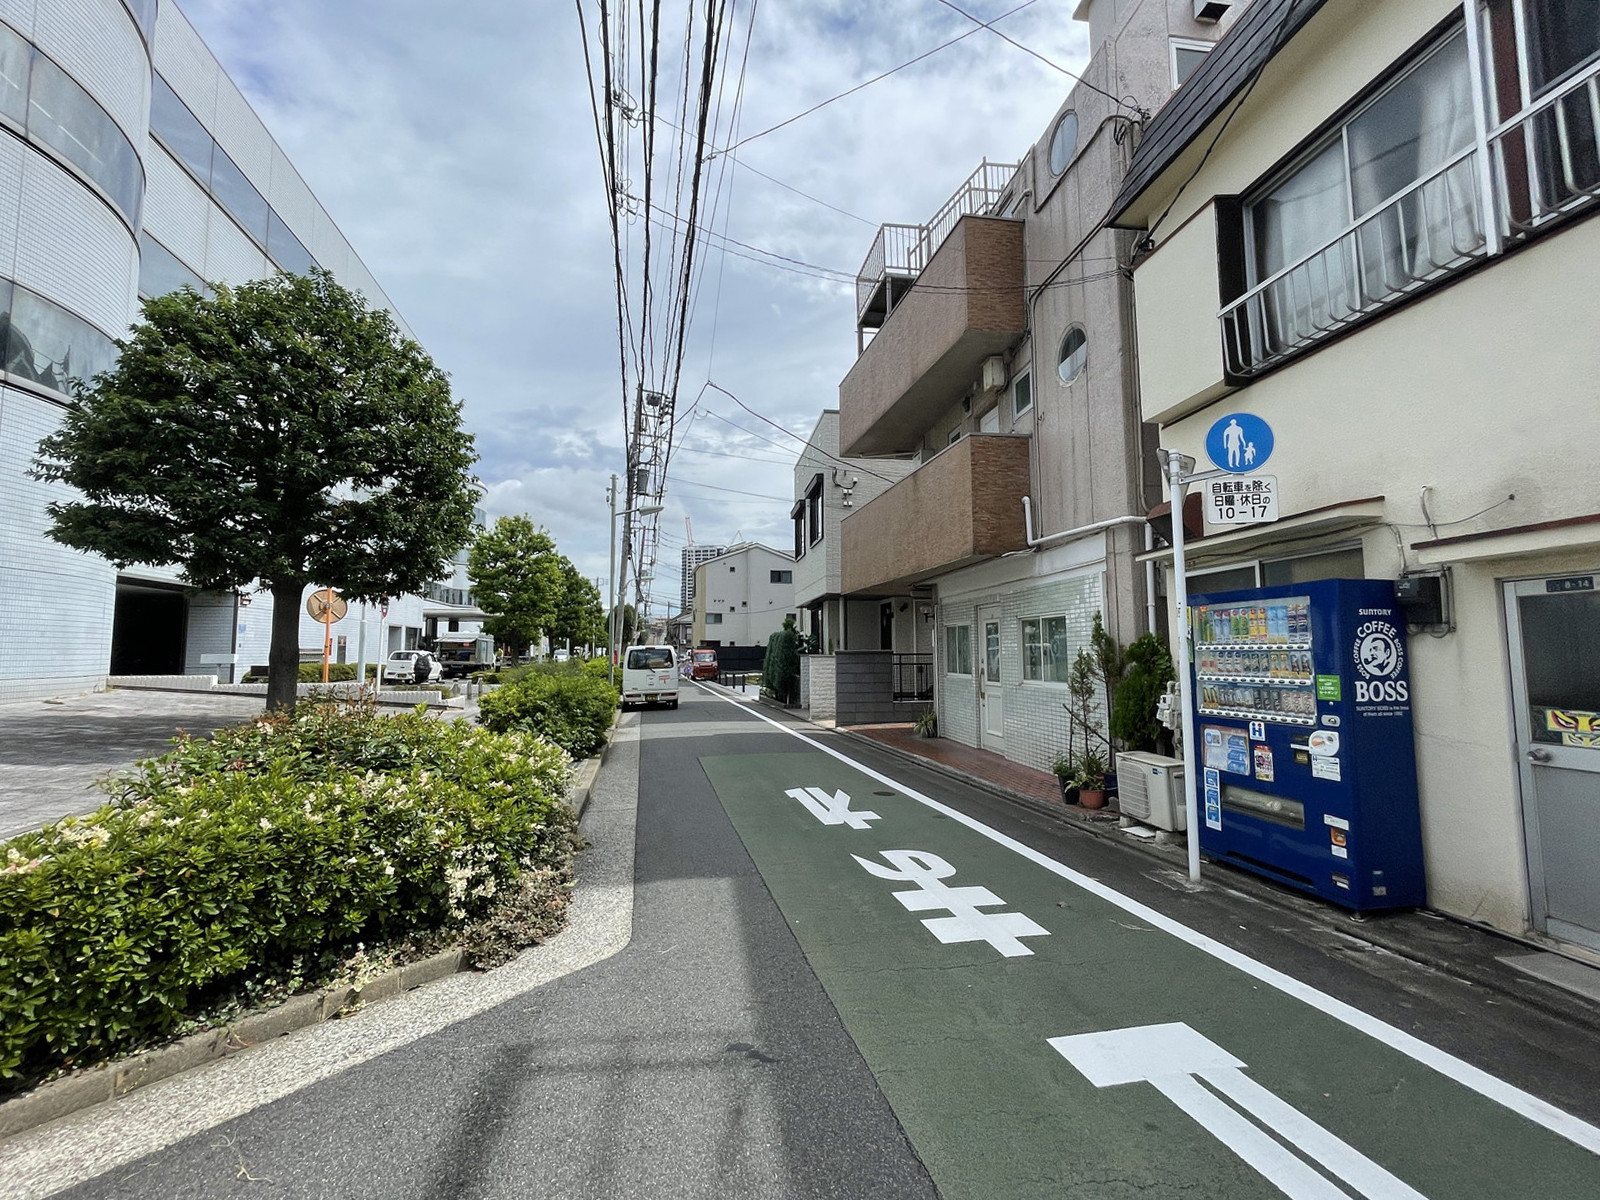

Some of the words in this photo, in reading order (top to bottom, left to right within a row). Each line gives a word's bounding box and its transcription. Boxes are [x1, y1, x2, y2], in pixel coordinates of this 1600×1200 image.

[1212, 480, 1271, 493] 自転車を除く
[1358, 608, 1392, 616] SUNTORY
[1357, 620, 1397, 639] COFFEE
[1353, 639, 1362, 664] COFFEE
[1393, 638, 1404, 656] BOSS
[1357, 664, 1370, 680] BOSS
[1390, 657, 1404, 679] COFFEE
[1354, 680, 1408, 702] BOSS
